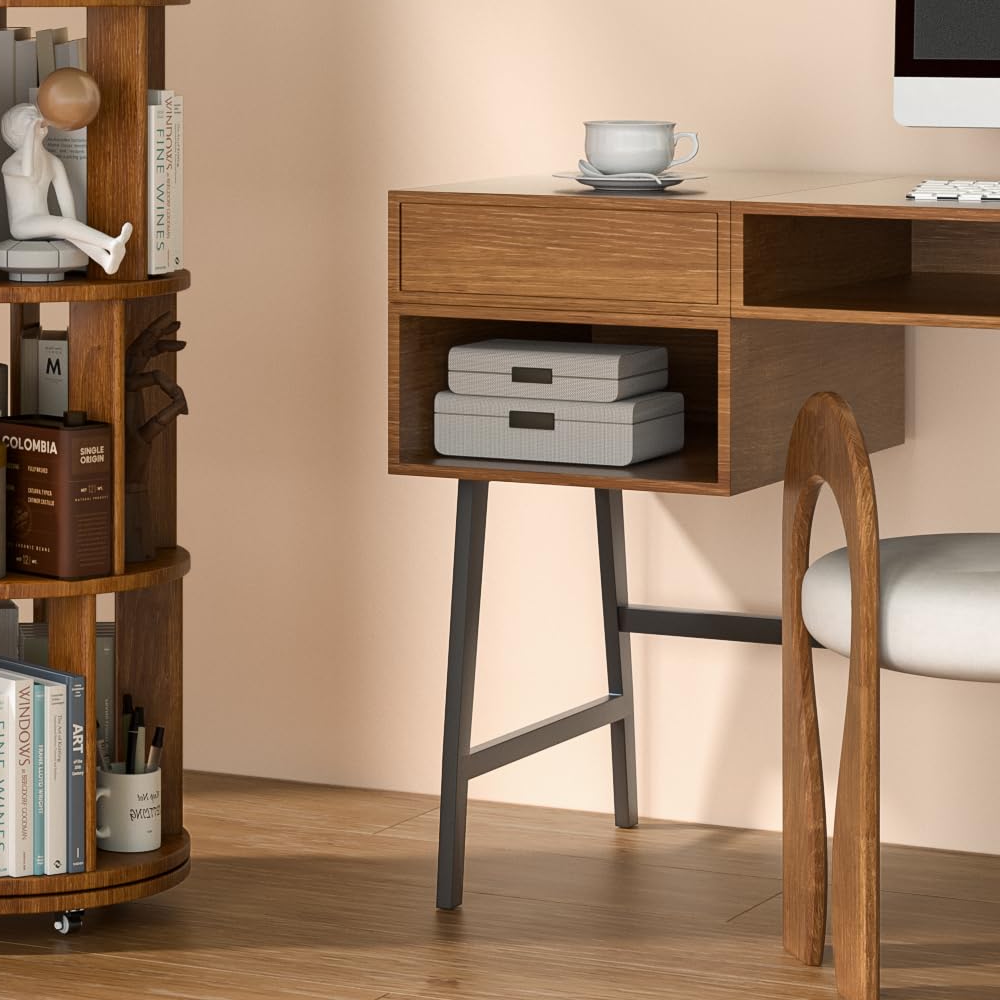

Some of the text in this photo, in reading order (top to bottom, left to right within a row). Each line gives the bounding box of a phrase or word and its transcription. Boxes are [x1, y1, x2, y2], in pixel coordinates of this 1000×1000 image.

[165, 97, 173, 170] WINDOWS
[156, 128, 165, 251] FINE WINES
[46, 357, 62, 376] M
[2, 435, 58, 455] COLOMBIA
[80, 446, 105, 456] SINGLE
[80, 454, 105, 464] ORIGIN
[18, 686, 31, 766] WINDOWS
[72, 723, 84, 753] ART
